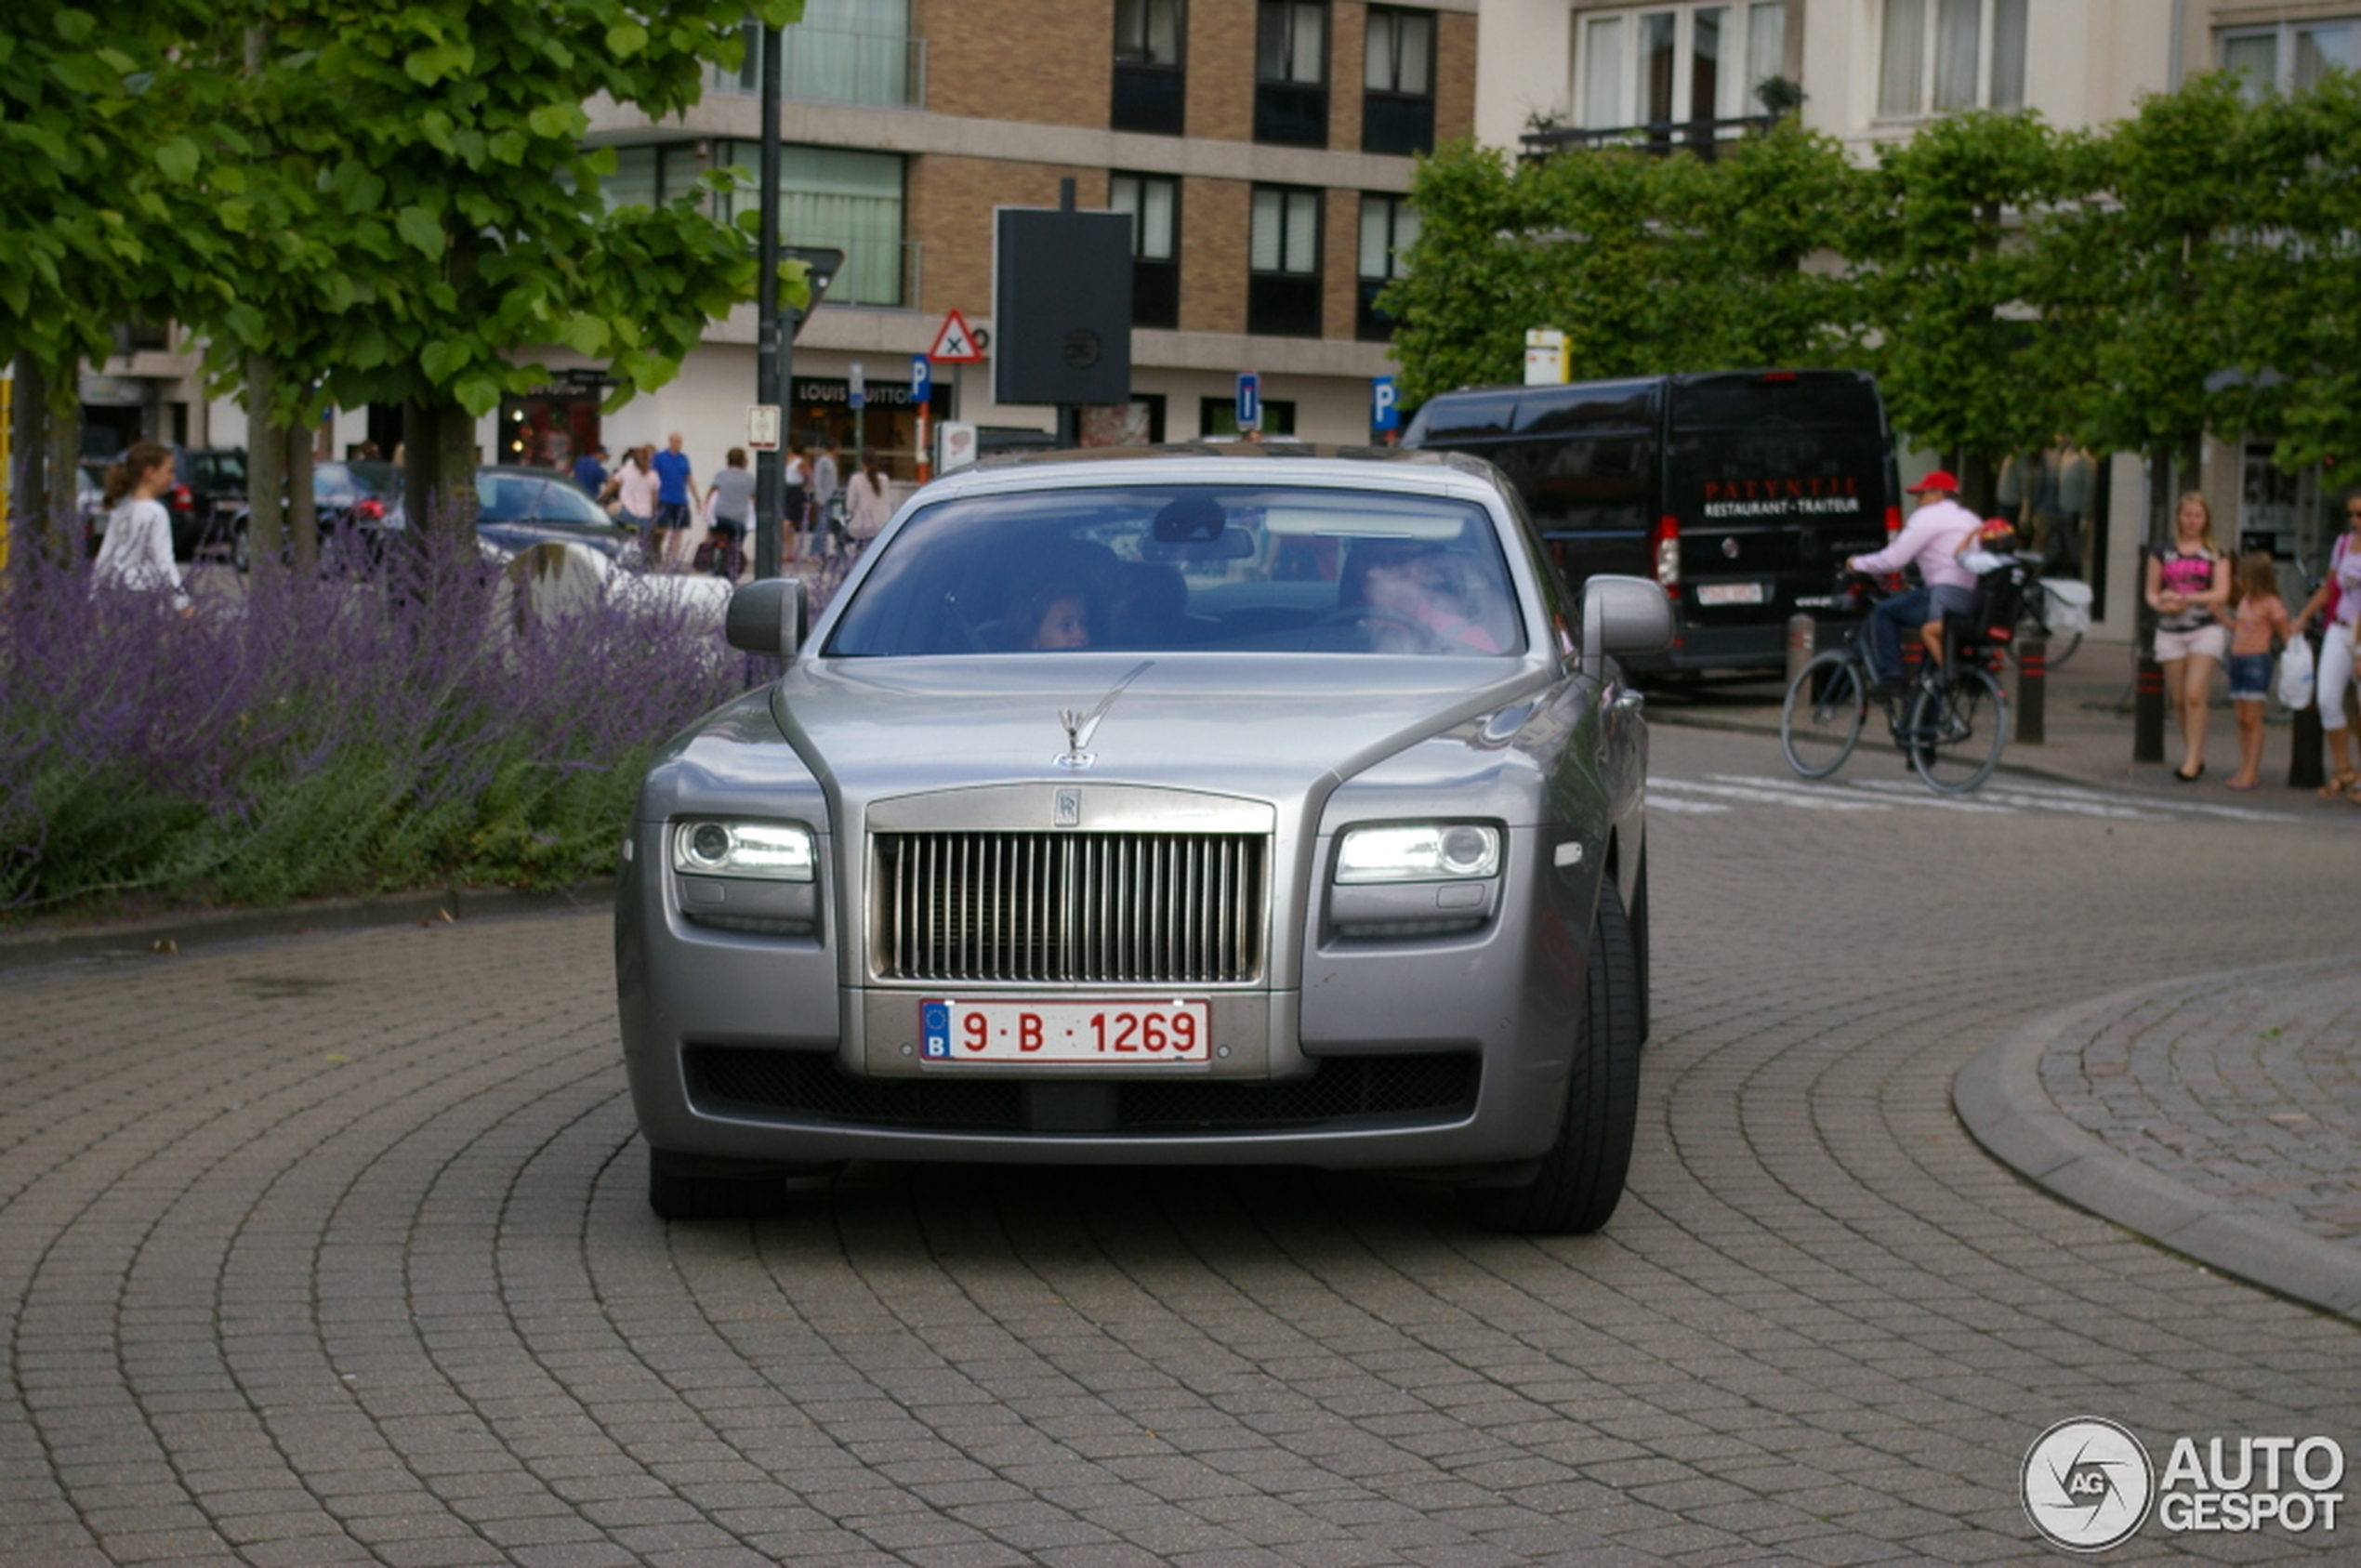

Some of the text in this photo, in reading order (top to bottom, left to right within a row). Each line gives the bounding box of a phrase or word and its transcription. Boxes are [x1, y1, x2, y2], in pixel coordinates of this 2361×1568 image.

[914, 361, 927, 395] P
[799, 383, 847, 402] LOUIS
[1376, 384, 1394, 423] P
[929, 1036, 945, 1056] B
